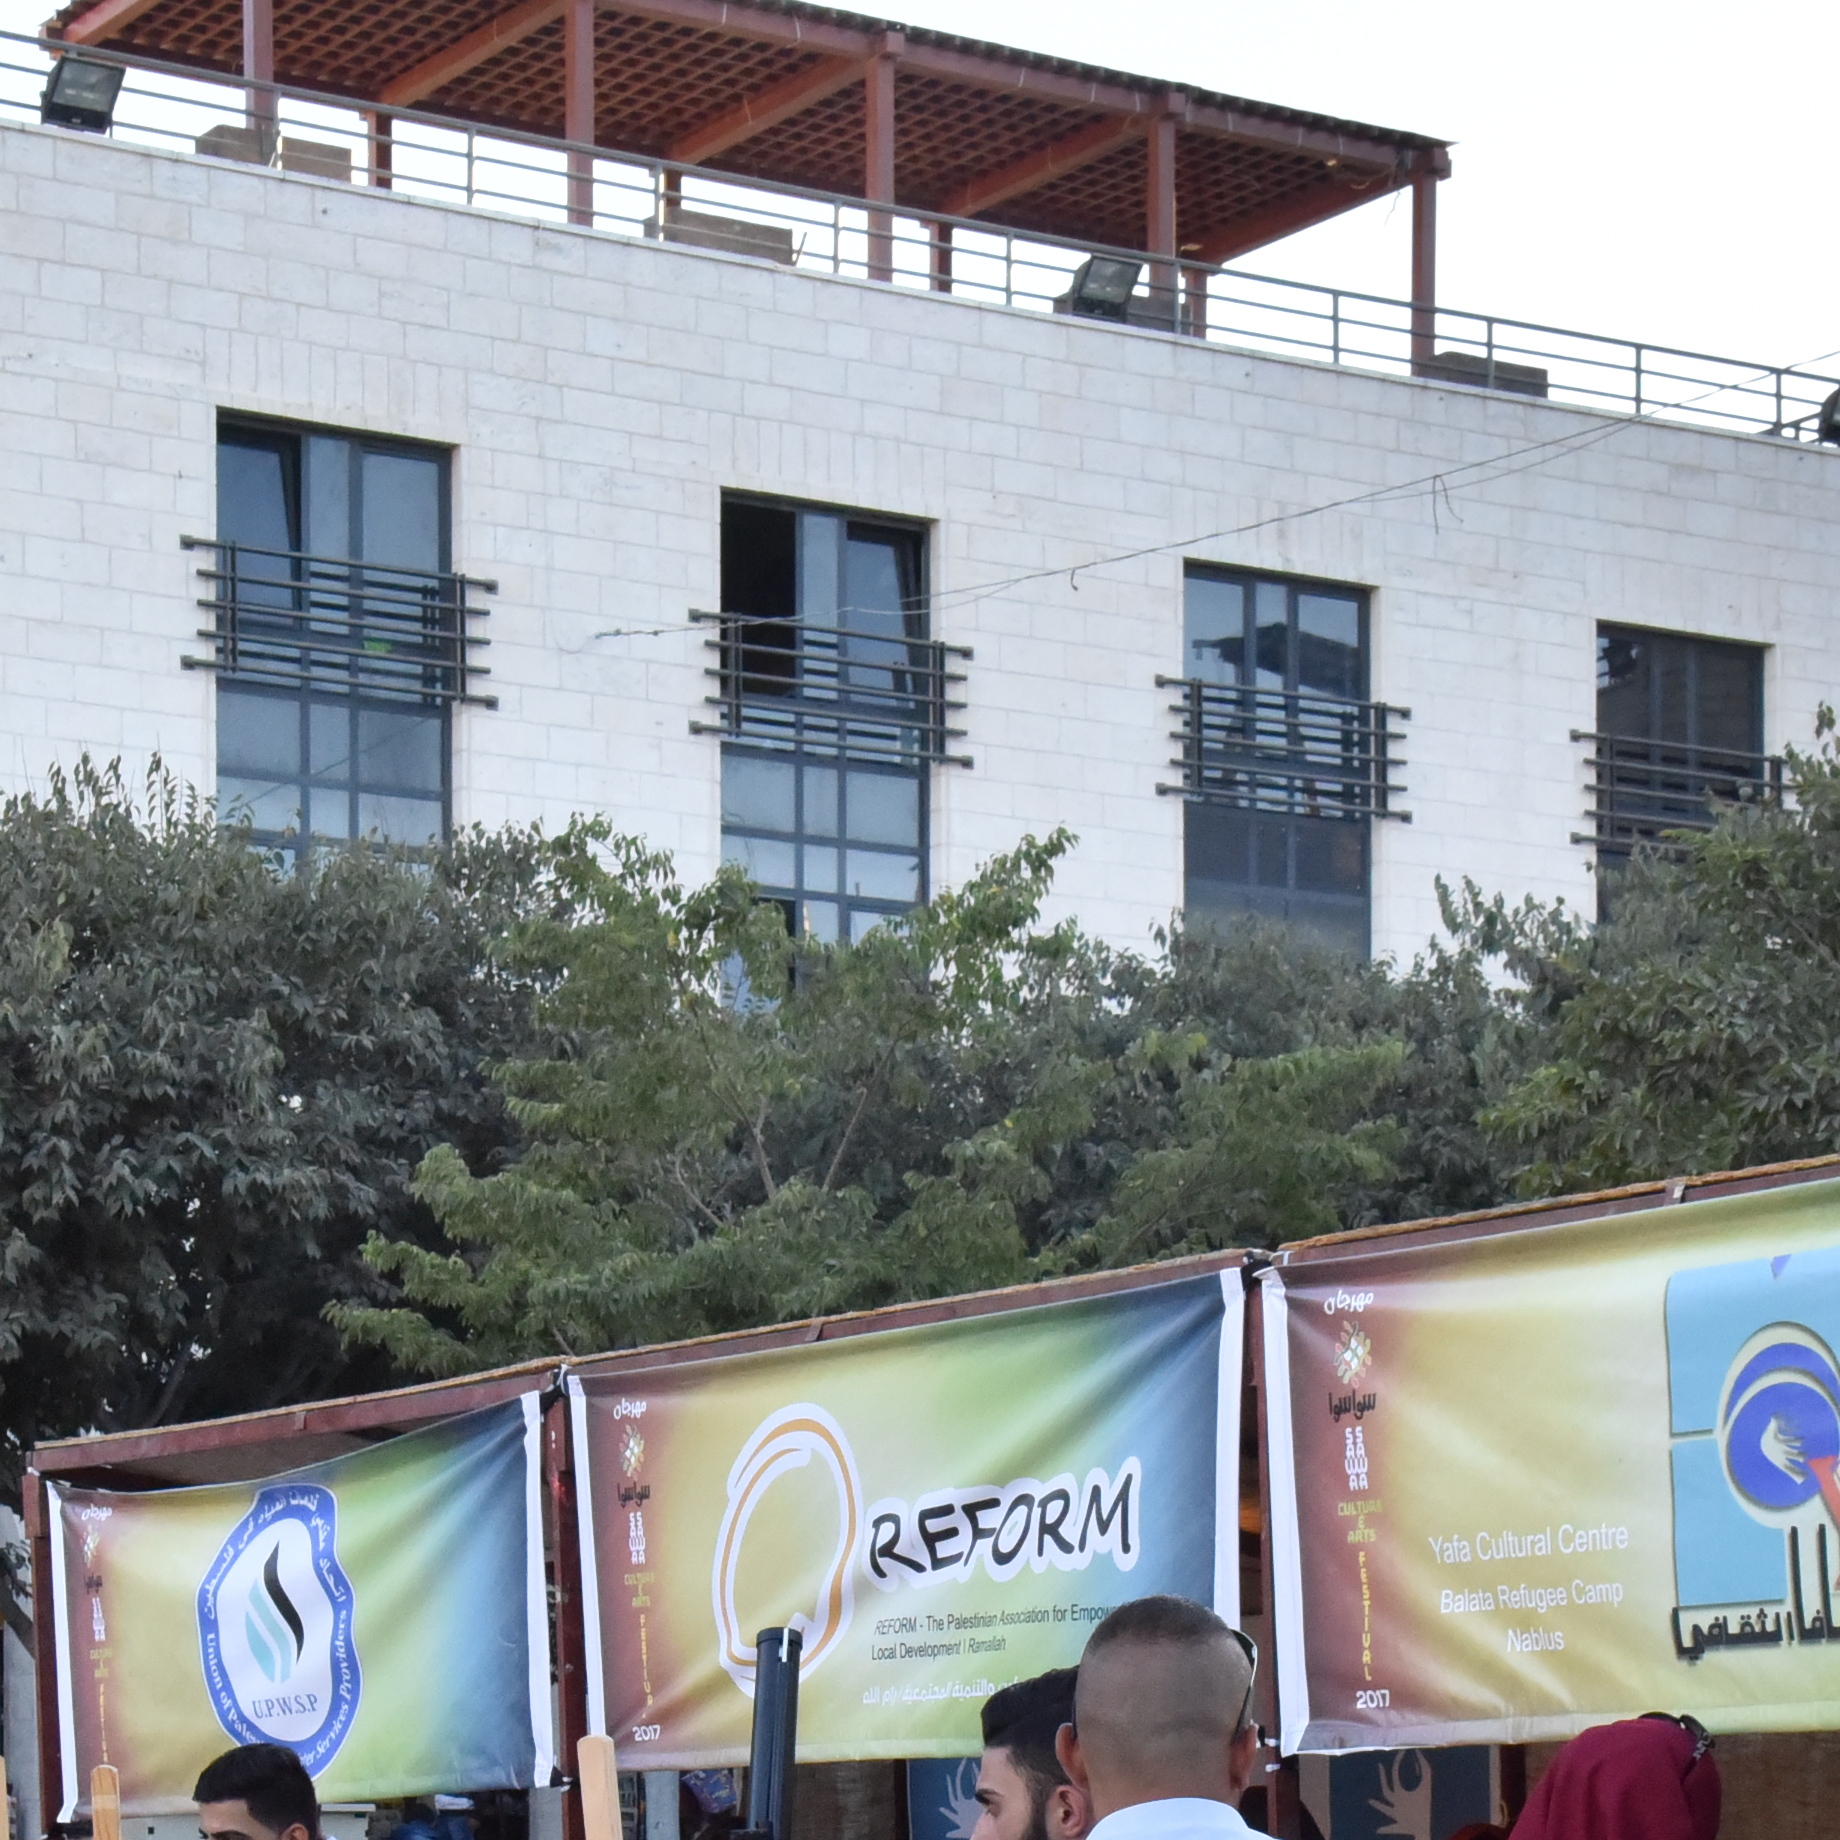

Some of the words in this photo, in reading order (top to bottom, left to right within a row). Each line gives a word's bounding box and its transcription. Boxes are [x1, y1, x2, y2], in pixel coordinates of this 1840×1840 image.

[1324, 1289, 1374, 1315] مهرجان
[613, 1398, 647, 1420] مهرجان
[1338, 1500, 1383, 1516] CULTURE
[868, 1473, 1134, 1579] REFORM
[1347, 1528, 1376, 1544] ARTS
[1428, 1534, 1472, 1564] Yafa
[1476, 1527, 1552, 1561] Cultural
[1558, 1522, 1629, 1554] Centre
[1440, 1589, 1495, 1613] Balata
[1497, 1584, 1567, 1613] Refugee
[1571, 1579, 1623, 1607] Camp
[874, 1616, 917, 1636] REFORM
[926, 1614, 944, 1632] The
[947, 1611, 997, 1631] Palestinian
[998, 1607, 1050, 1626] Association
[1052, 1606, 1068, 1621] for
[1672, 1606, 1795, 1661] الثقافي
[871, 1643, 897, 1661] Local
[900, 1639, 961, 1662] Development
[968, 1635, 1006, 1652] Ramallah
[1507, 1626, 1564, 1652] Nablus
[206, 1633, 223, 1690] Union
[220, 1690, 233, 1711] of
[315, 1703, 349, 1758] Services
[334, 1610, 352, 1700] Providers
[252, 1693, 318, 1719] U.P.W.S.P
[1356, 1689, 1390, 1709] 2017
[632, 1724, 660, 1742] 2017
